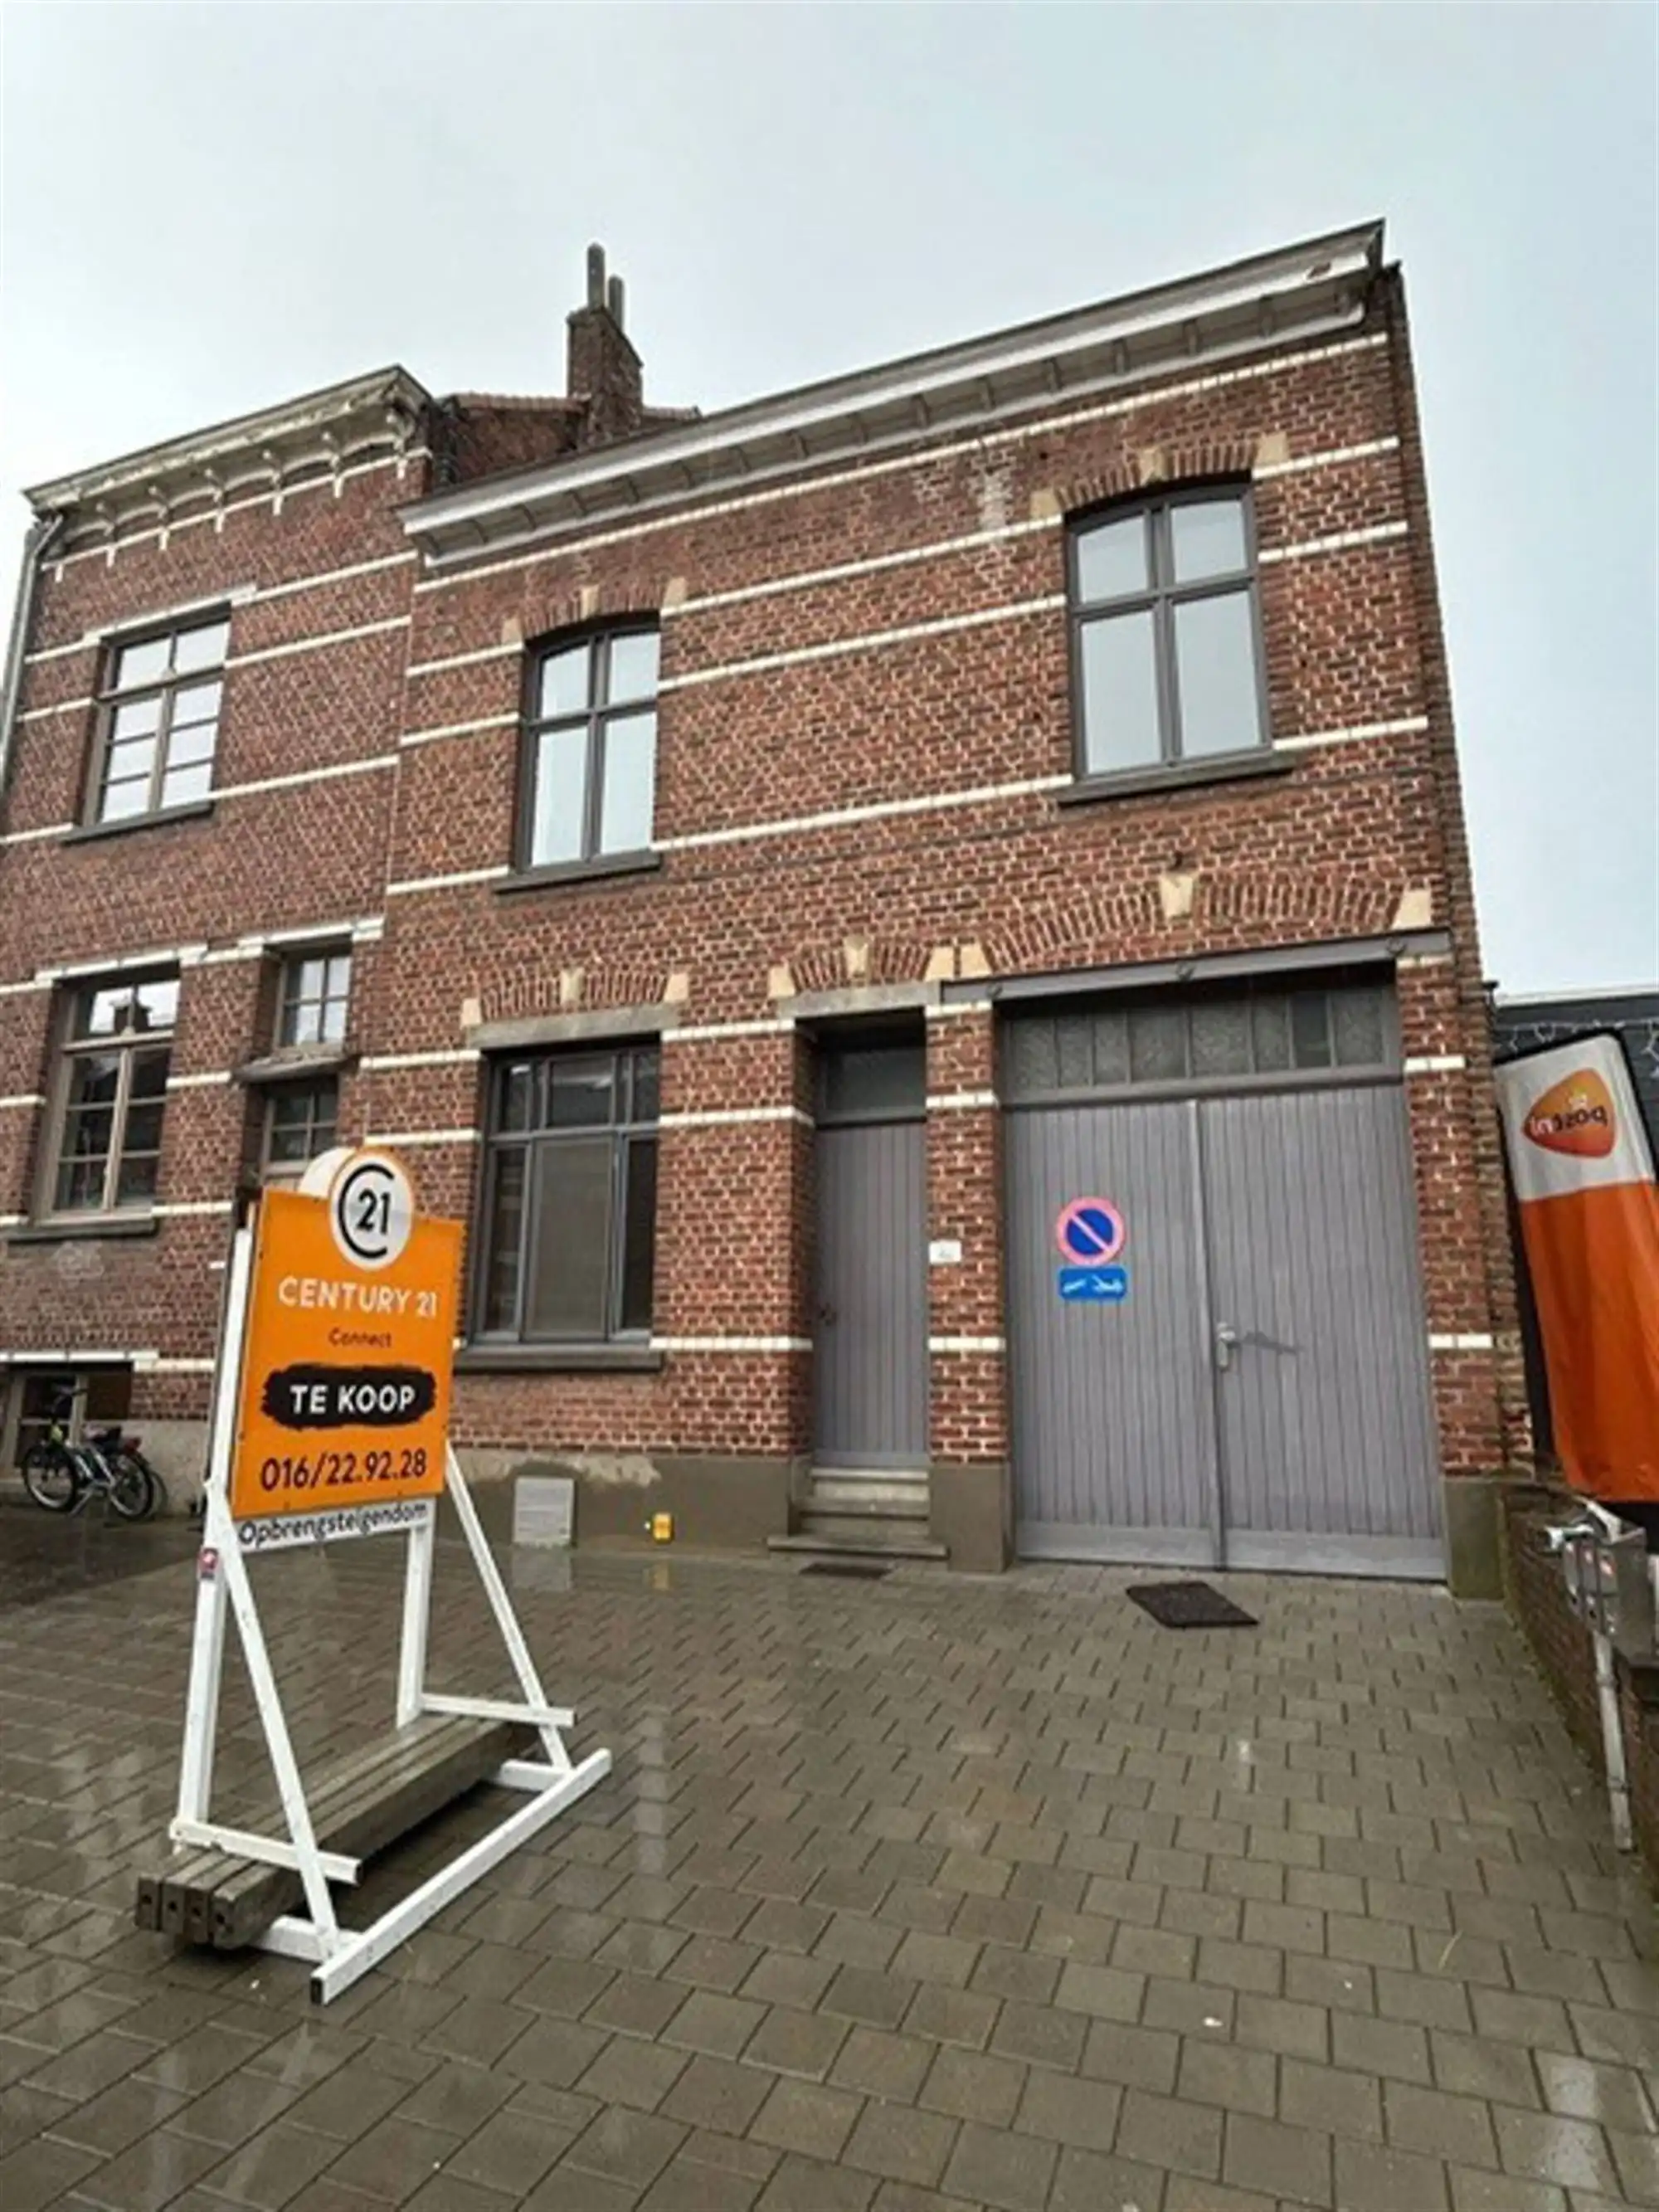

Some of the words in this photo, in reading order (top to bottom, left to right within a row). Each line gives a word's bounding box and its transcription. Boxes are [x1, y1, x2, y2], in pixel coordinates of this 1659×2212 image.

[278, 1275, 413, 1318] CENTURY
[416, 1289, 438, 1318] 21
[328, 1328, 392, 1350] Connect
[289, 1384, 327, 1414] TE
[338, 1384, 416, 1414] KOOP
[260, 1448, 427, 1492] 016/22.92.28
[239, 1502, 427, 1549] Opbrengsteigendom
